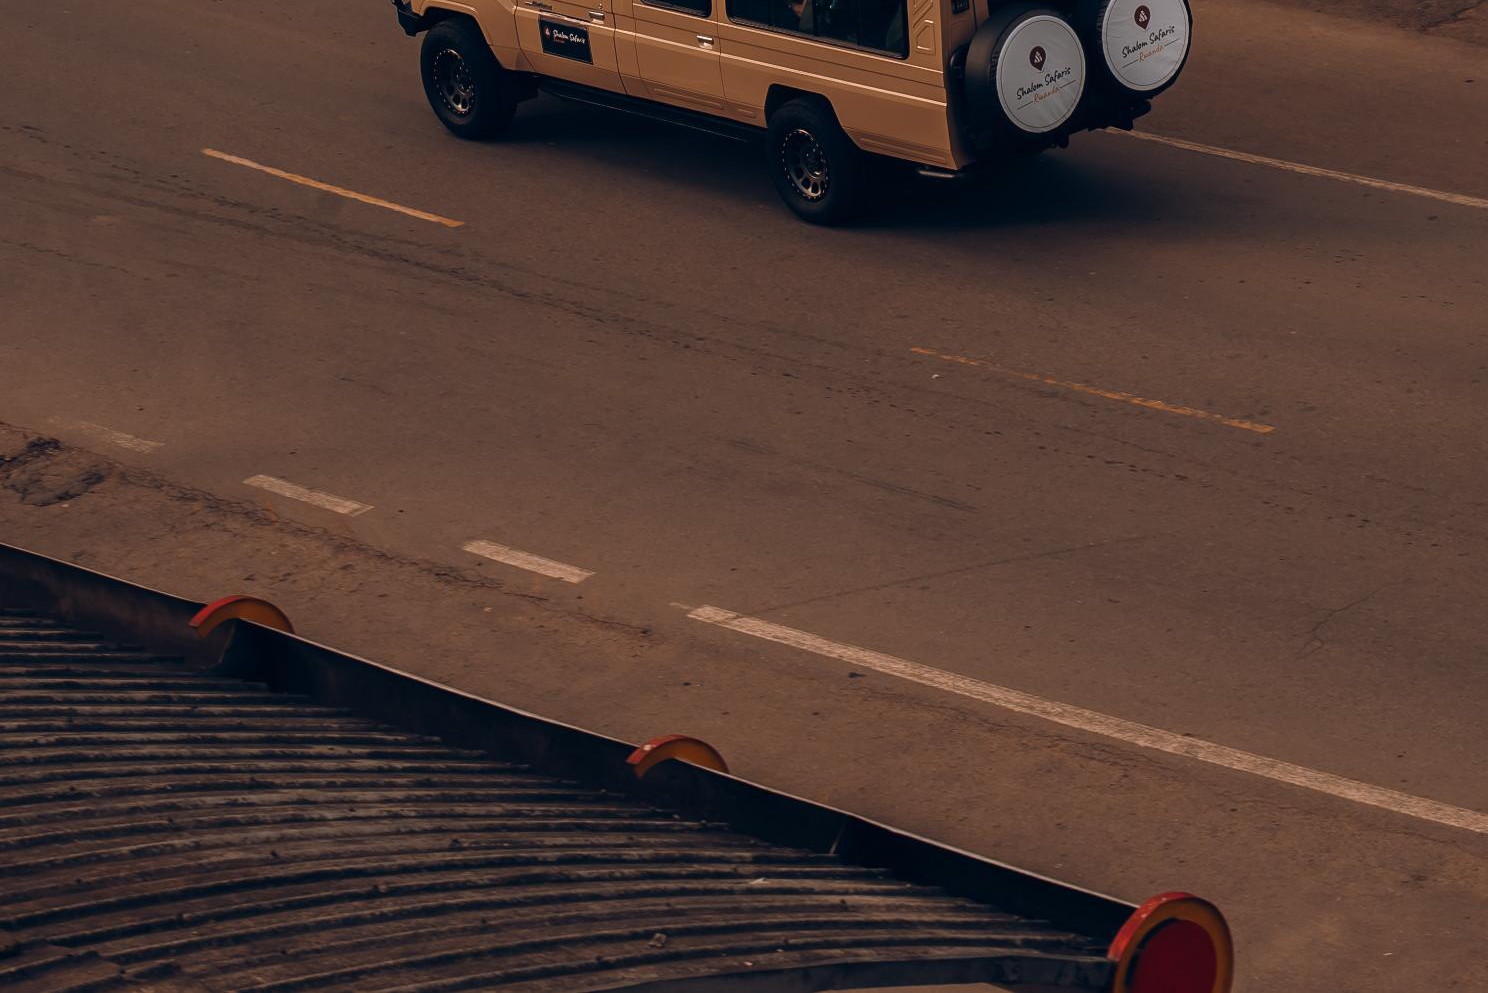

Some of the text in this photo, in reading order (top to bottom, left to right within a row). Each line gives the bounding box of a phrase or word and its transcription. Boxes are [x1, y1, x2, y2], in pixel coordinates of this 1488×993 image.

[1121, 25, 1175, 59] Shalom Safaris
[1138, 45, 1164, 63] Rwanda
[1016, 66, 1071, 100] Shalom Safaris
[1033, 86, 1060, 105] Rwanda
